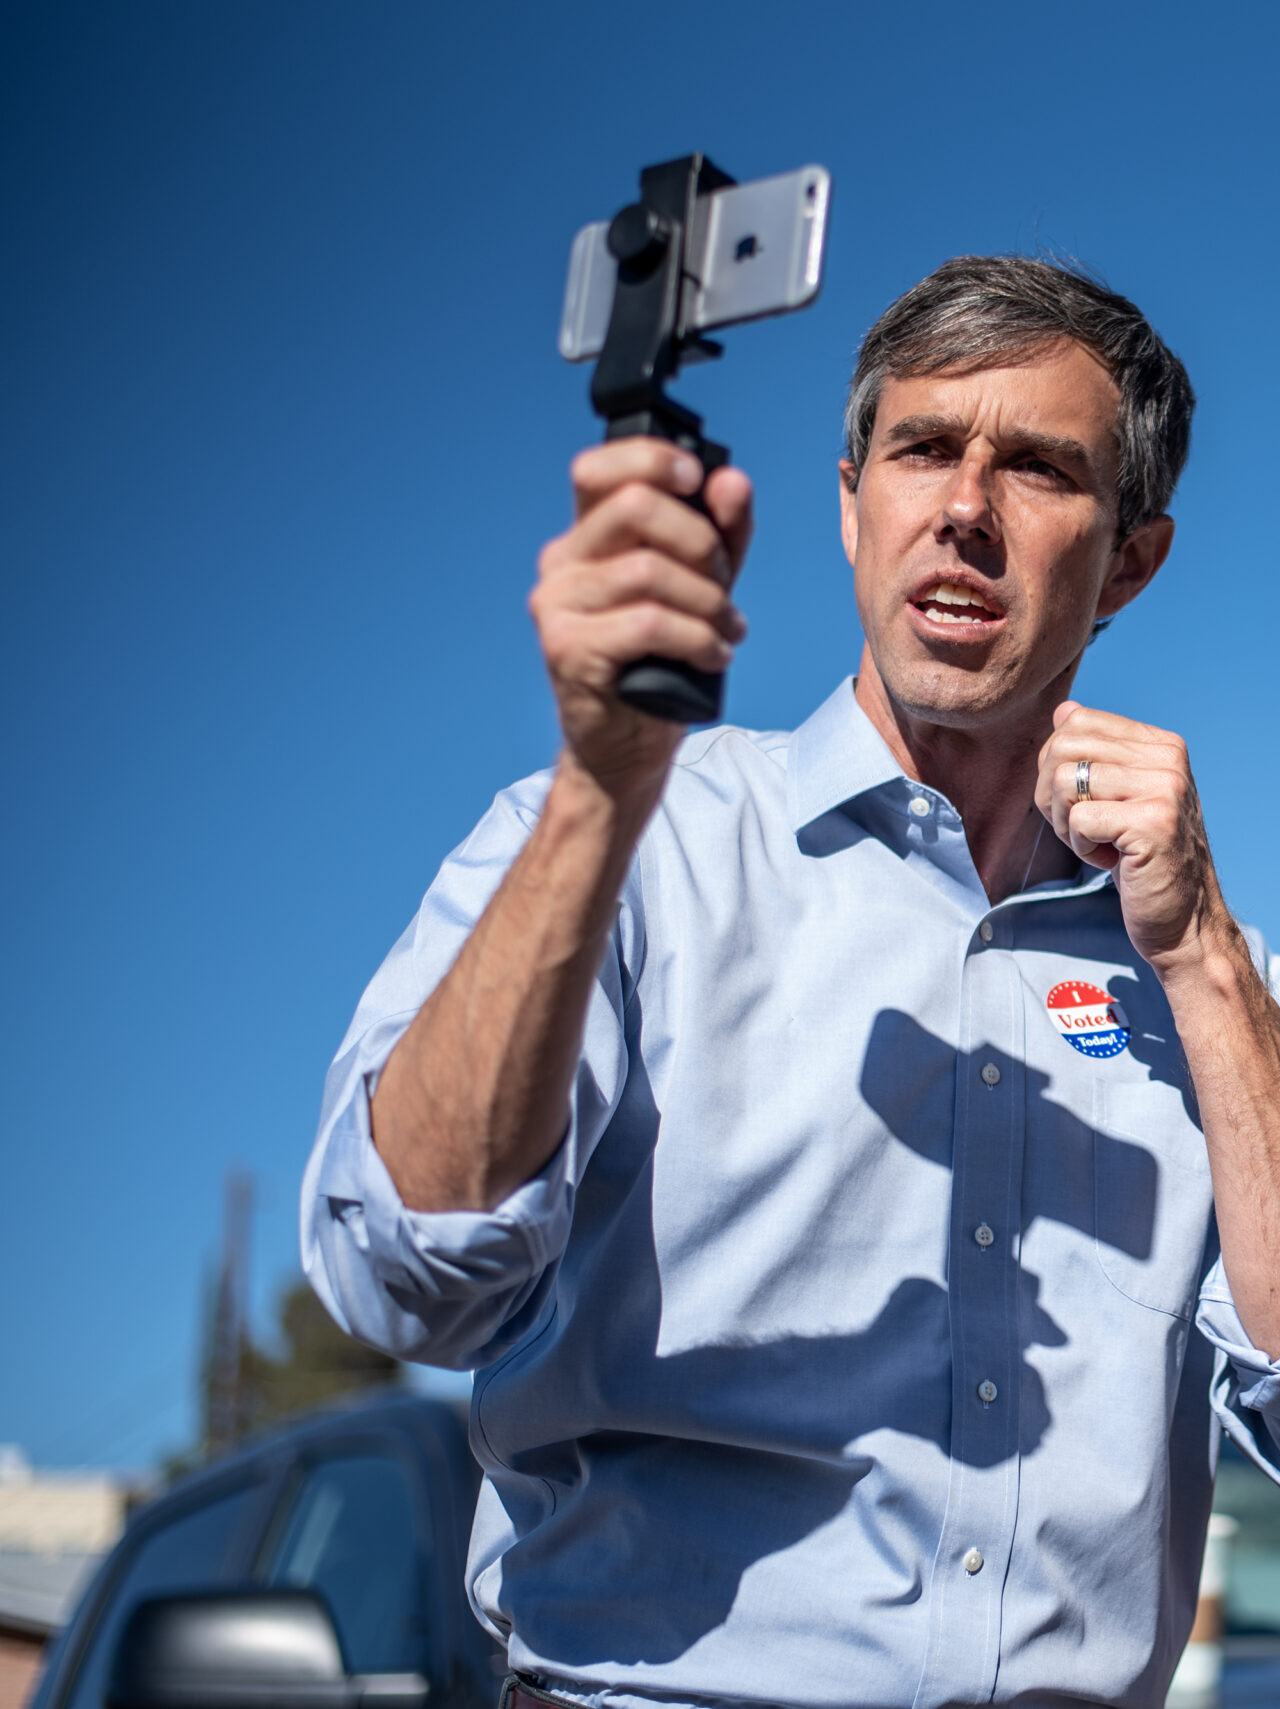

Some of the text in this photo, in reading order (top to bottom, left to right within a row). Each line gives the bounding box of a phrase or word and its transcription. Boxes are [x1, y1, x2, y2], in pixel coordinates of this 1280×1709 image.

[1072, 991, 1082, 1003] I
[1057, 1008, 1120, 1029] Voted
[1077, 1032, 1118, 1047] Today!
